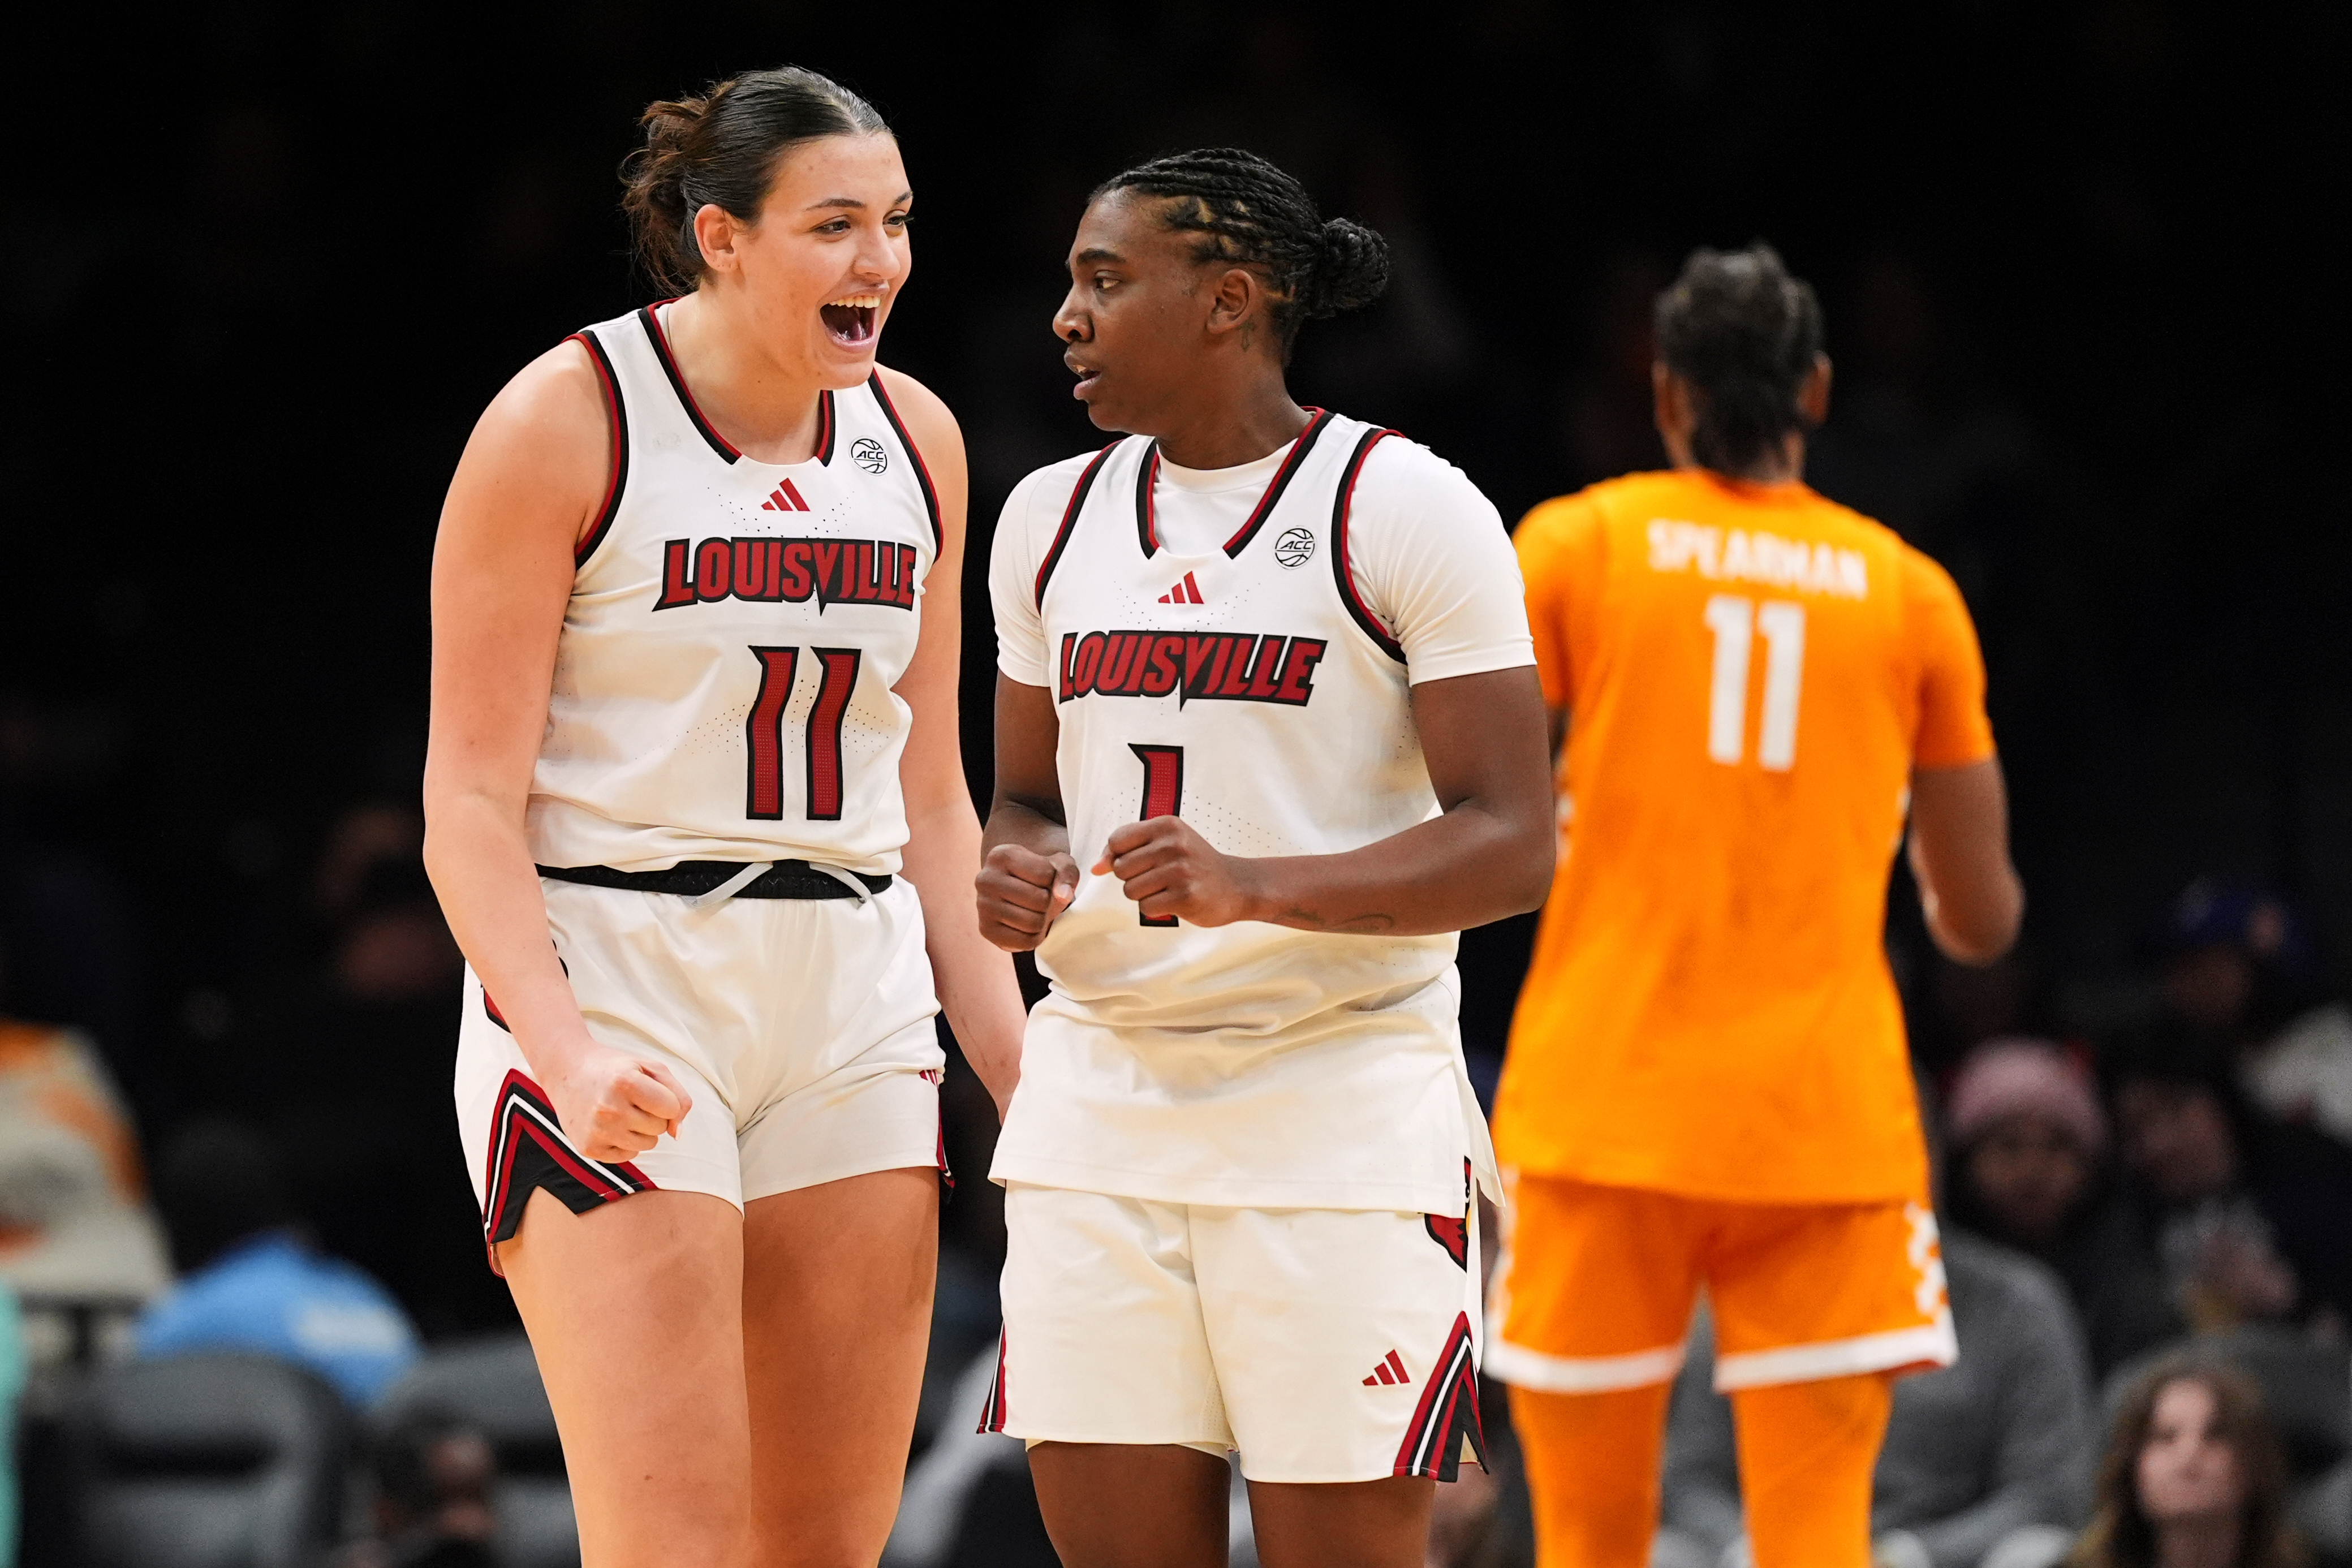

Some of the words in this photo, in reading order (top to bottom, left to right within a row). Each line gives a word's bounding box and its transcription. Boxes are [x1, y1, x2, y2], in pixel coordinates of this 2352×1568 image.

[856, 451, 884, 459] ACC
[652, 537, 916, 616] LOUISVILLE
[1280, 541, 1314, 549] ACC
[1059, 630, 1328, 712] LOUISVILLE
[1704, 594, 1806, 773] 11
[746, 645, 861, 820] 11
